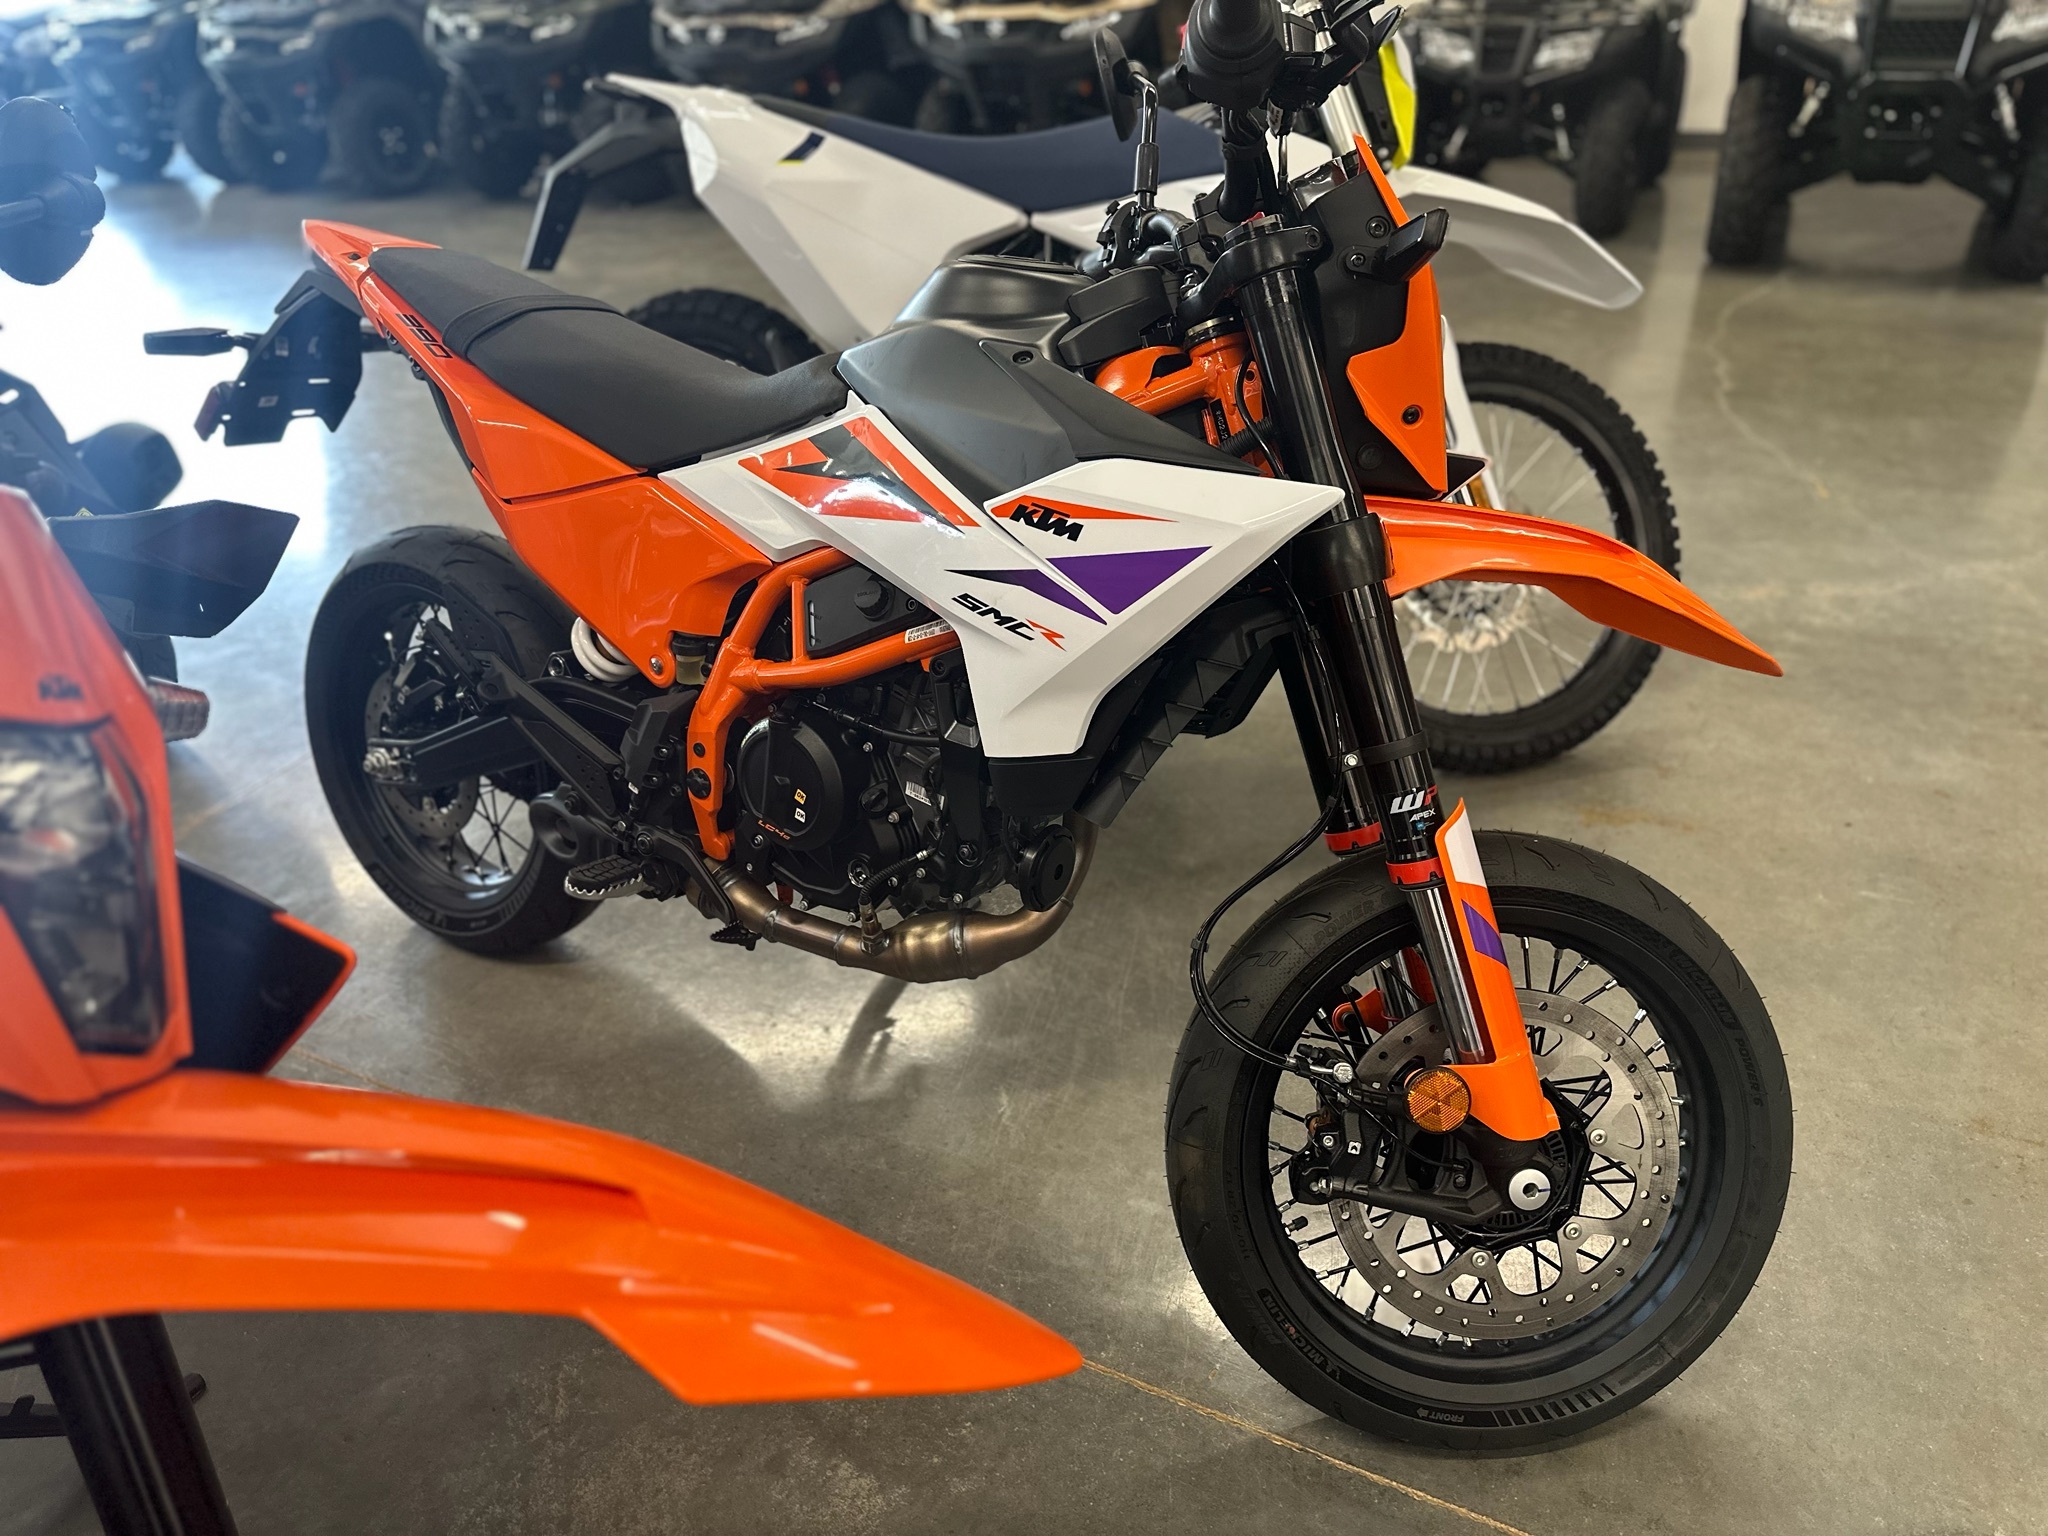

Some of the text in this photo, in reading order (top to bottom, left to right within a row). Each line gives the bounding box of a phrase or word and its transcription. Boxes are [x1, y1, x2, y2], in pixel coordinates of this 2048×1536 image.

[396, 313, 453, 359] 390
[1009, 502, 1084, 542] KTM
[796, 791, 805, 801] OK
[1390, 785, 1437, 814] WP
[796, 810, 805, 820] OK
[1409, 808, 1436, 822] APEX
[1735, 1038, 1761, 1092] POWER
[1263, 1294, 1325, 1365] MICHELIN
[1429, 1411, 1465, 1423] FRONT
